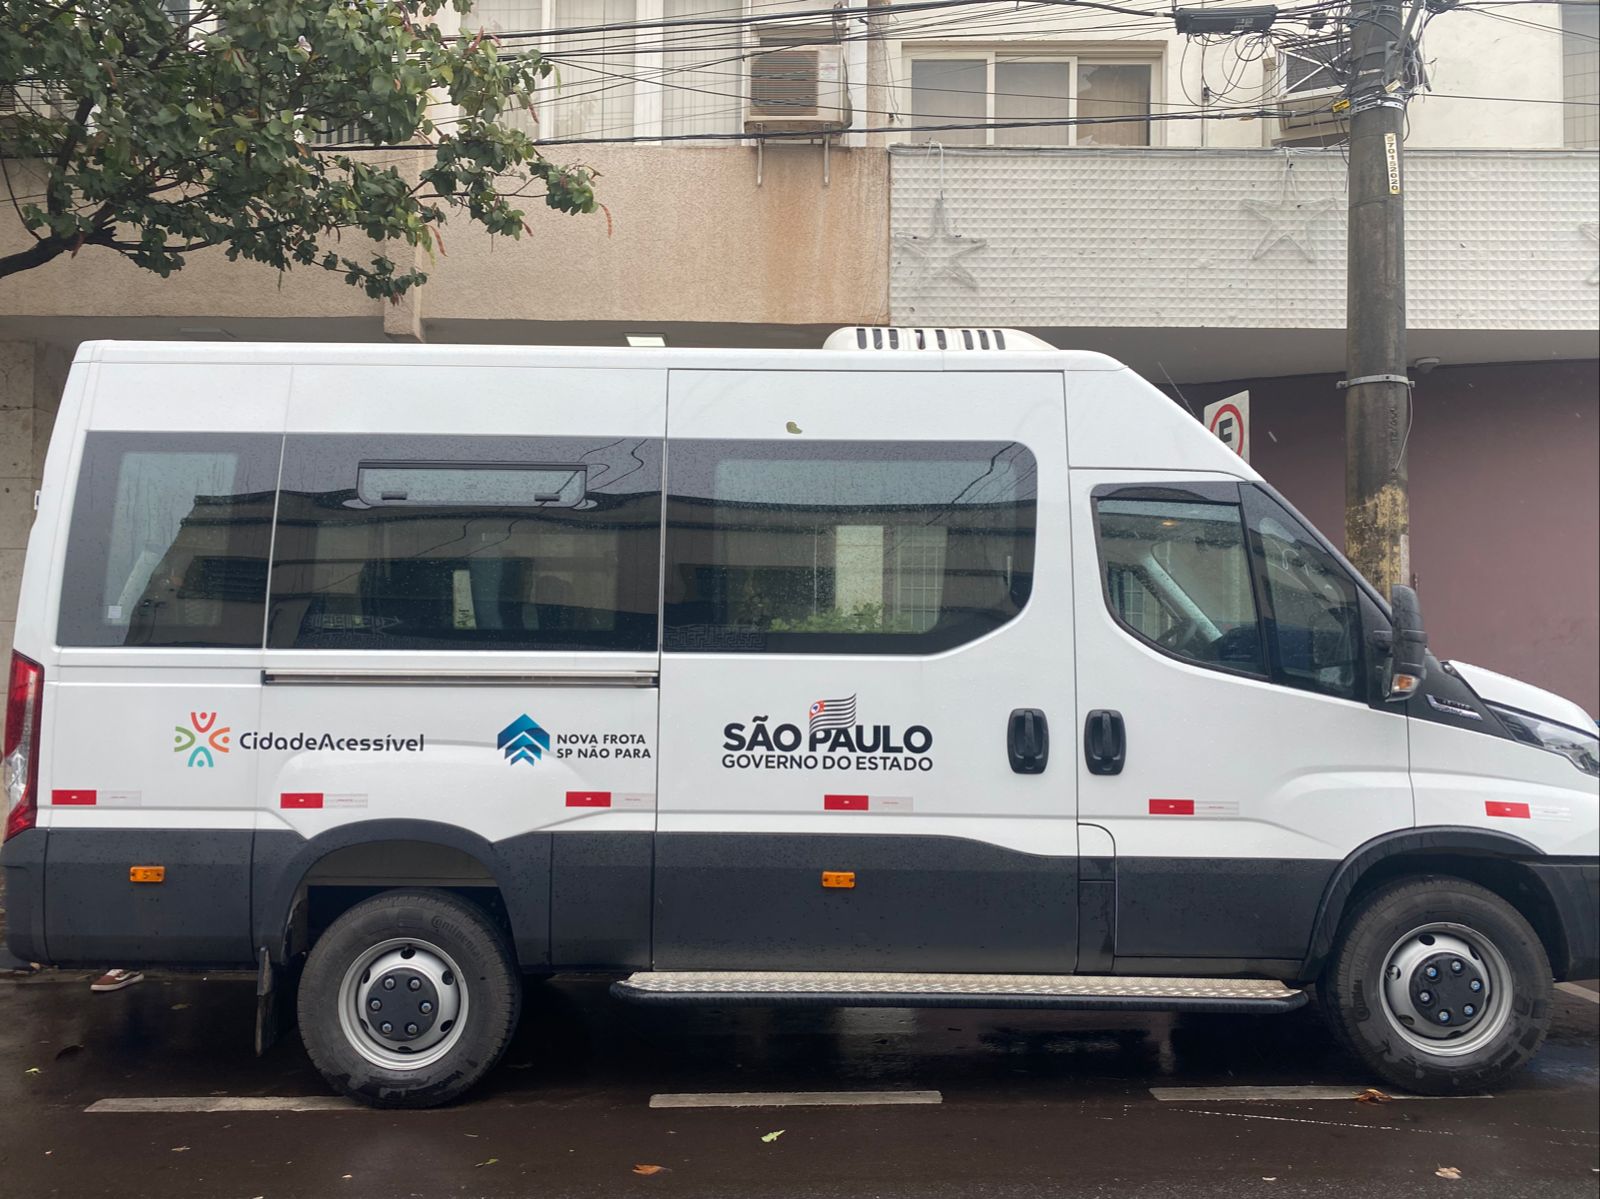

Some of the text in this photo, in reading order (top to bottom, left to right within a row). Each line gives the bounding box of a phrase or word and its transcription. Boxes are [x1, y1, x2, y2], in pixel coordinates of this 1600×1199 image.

[1386, 136, 1399, 191] 570152020
[1218, 417, 1233, 451] E
[239, 731, 424, 752] CidadeAcessível
[557, 734, 646, 744] NOVA FROTA
[723, 715, 933, 754] SÃO PAULO
[557, 745, 651, 758] SP NÃO PARA
[722, 753, 933, 771] GOVERNO DO ESTADO
